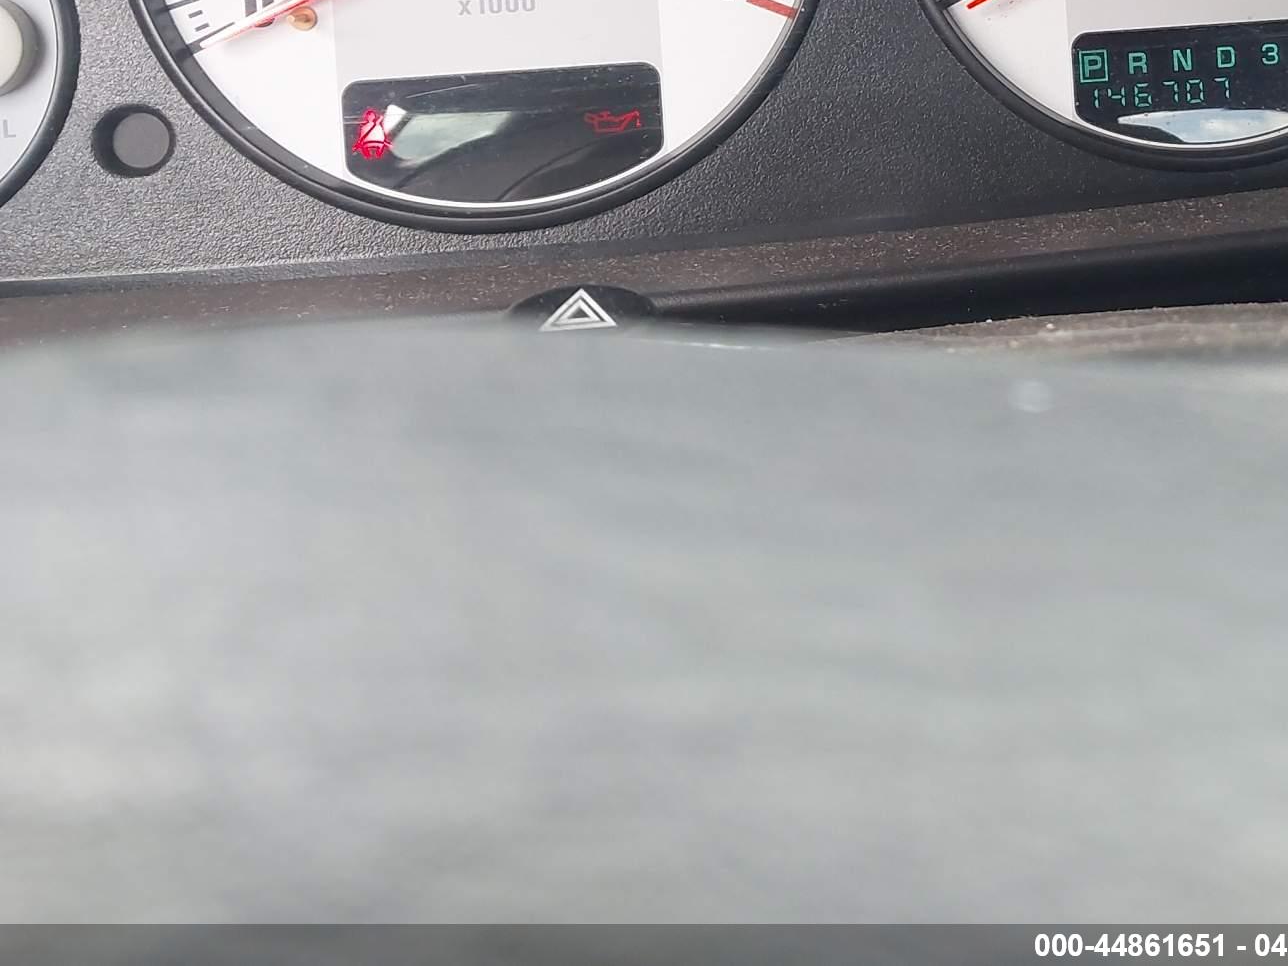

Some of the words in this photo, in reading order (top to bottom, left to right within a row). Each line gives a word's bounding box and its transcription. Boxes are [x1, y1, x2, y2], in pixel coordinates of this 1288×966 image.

[1084, 55, 1102, 78] P
[1128, 52, 1149, 75] R
[1173, 48, 1194, 72] N
[1216, 45, 1237, 69] D
[1261, 42, 1280, 65] 3
[1093, 77, 1230, 109] 146707
